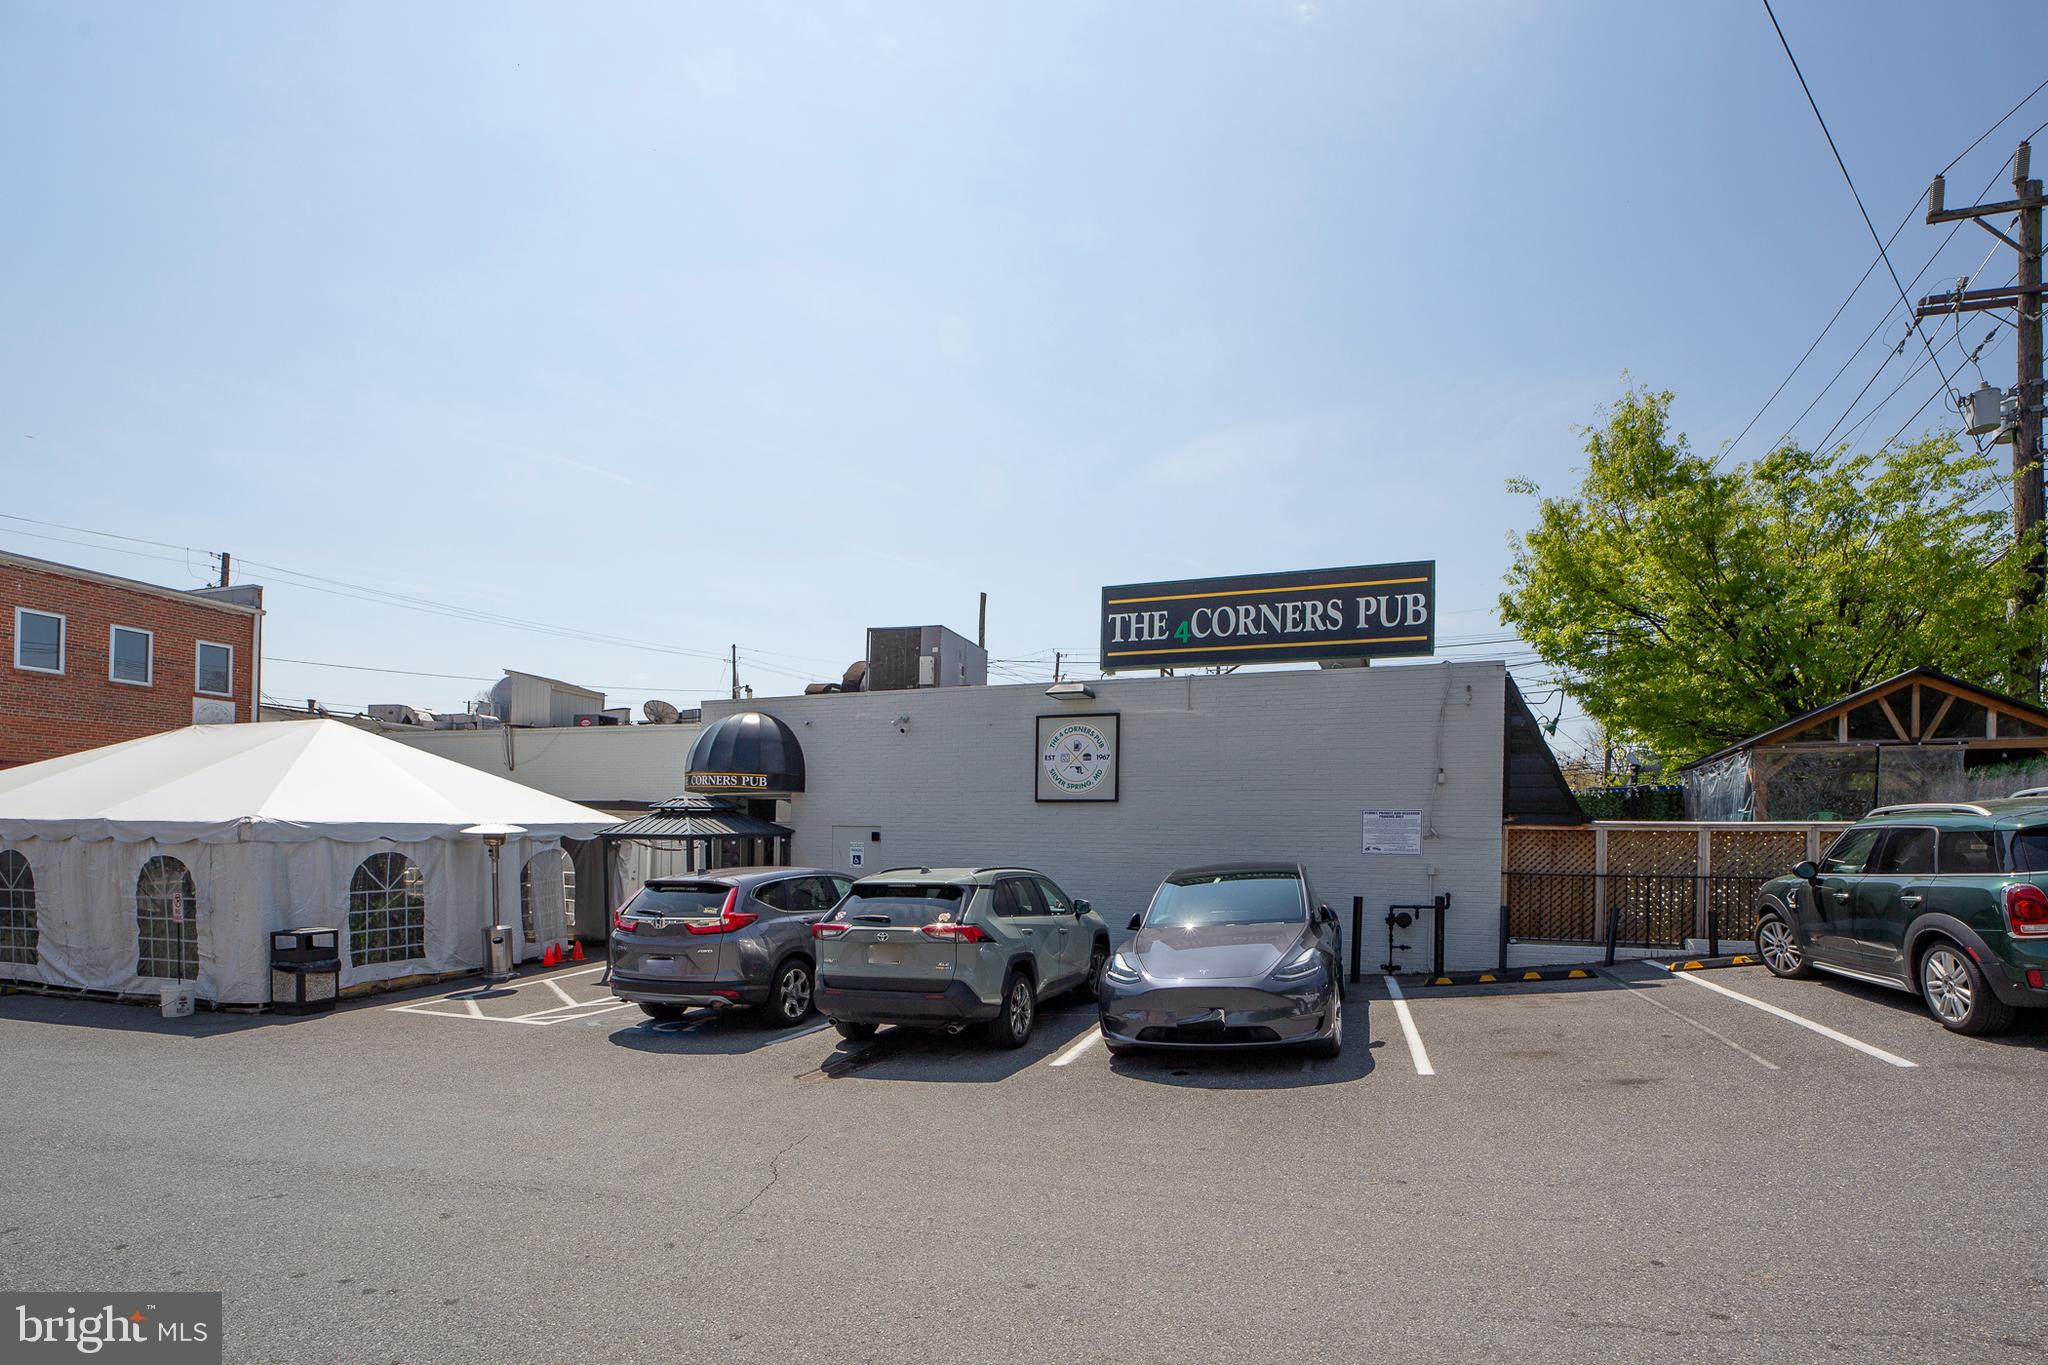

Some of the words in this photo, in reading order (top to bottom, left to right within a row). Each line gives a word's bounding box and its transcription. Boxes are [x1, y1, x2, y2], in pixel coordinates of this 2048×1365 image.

[1108, 610, 1169, 643] THE
[1355, 592, 1428, 629] PUB
[1049, 736, 1060, 748] THE
[1064, 726, 1095, 736] CORNERS
[1094, 734, 1105, 749] PUB
[691, 775, 738, 786] CORNERS
[741, 775, 768, 787] PUB
[1049, 768, 1066, 786] SILVER
[1093, 769, 1103, 781] MD
